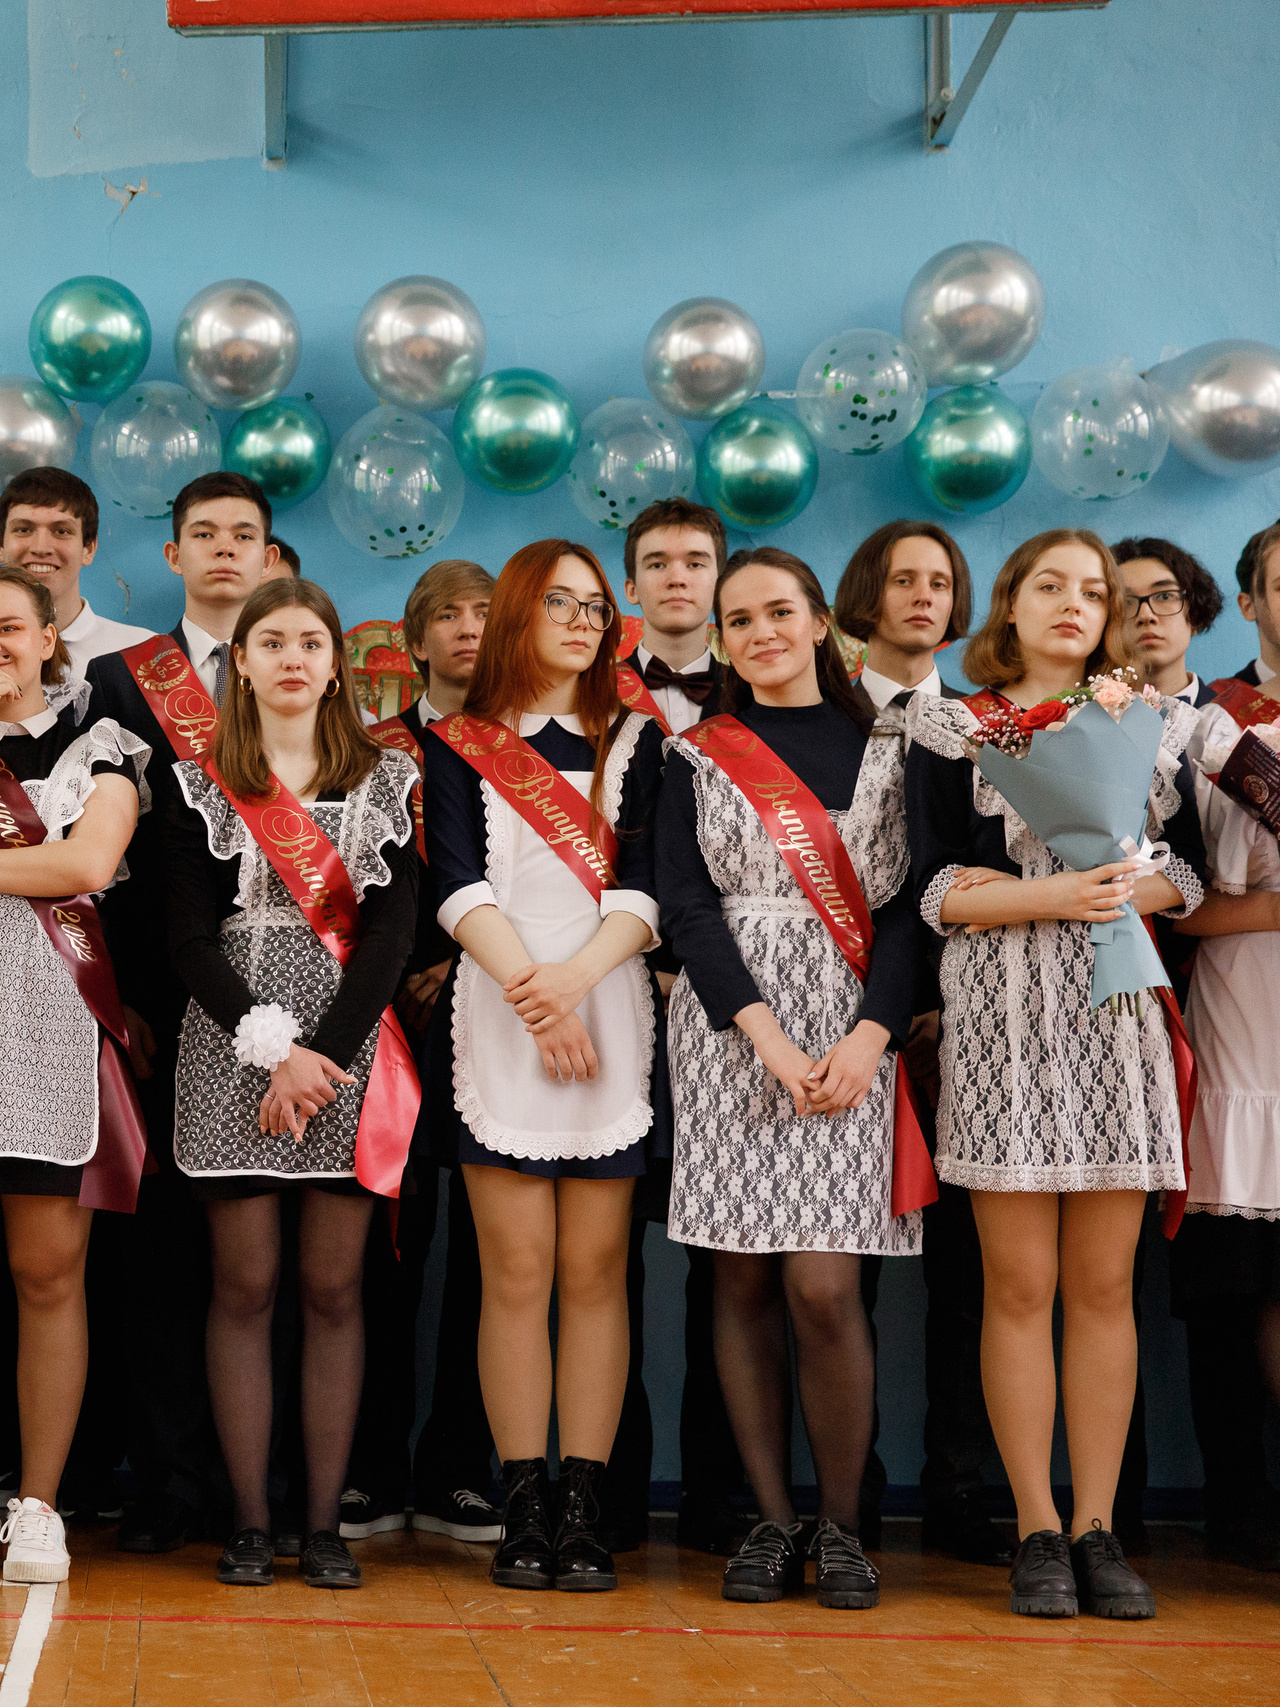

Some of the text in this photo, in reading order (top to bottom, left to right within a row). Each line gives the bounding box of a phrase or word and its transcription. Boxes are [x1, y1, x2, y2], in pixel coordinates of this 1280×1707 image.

[166, 658, 182, 670] 11
[742, 758, 854, 928] Выпускник
[52, 905, 97, 963] 2022
